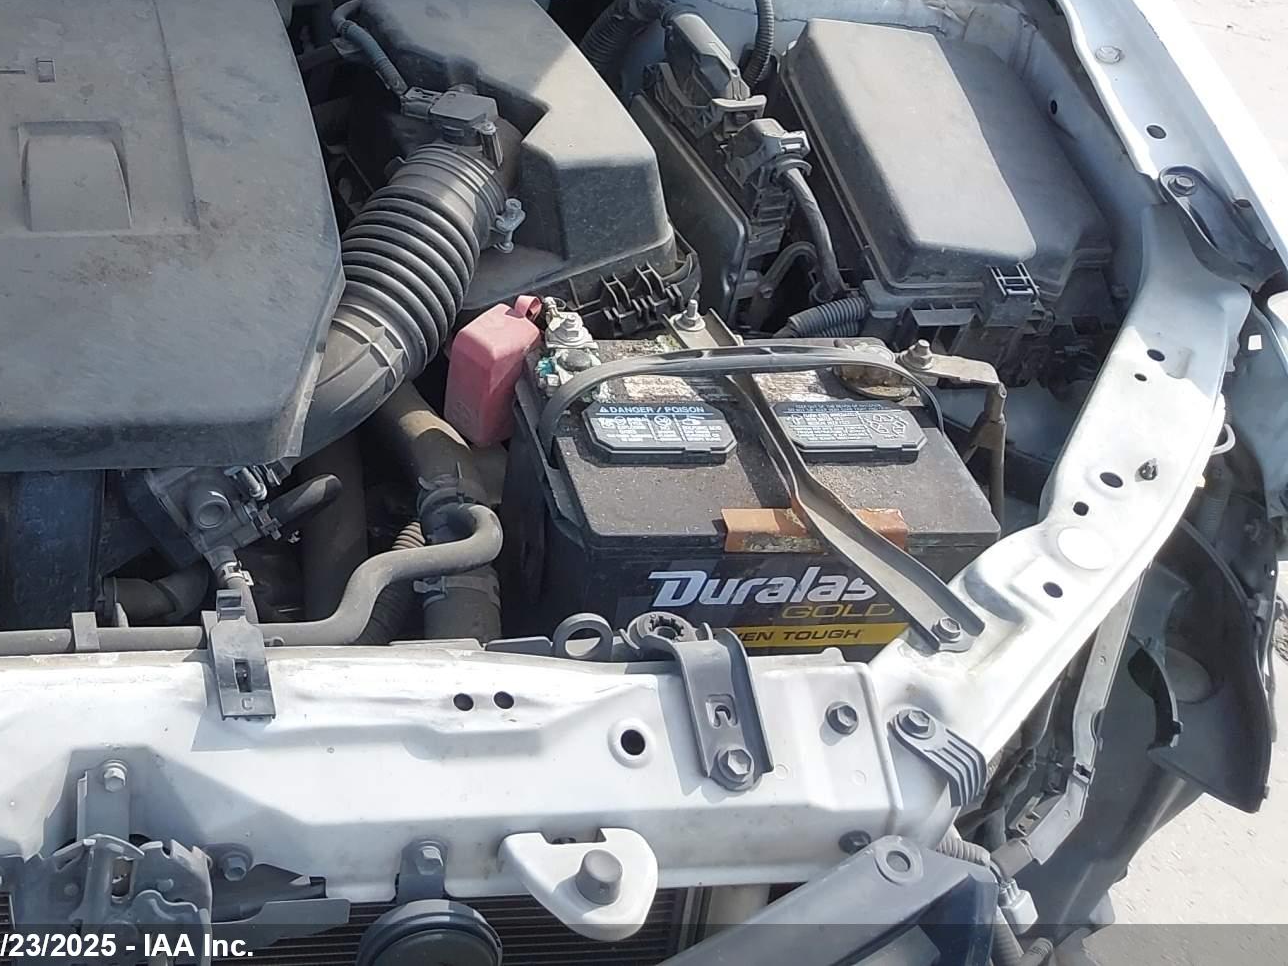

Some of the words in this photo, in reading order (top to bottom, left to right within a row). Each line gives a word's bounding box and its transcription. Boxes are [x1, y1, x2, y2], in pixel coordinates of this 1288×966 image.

[648, 567, 877, 607] Duralas
[782, 603, 895, 618] GOLD
[784, 629, 861, 641] TOUGH
